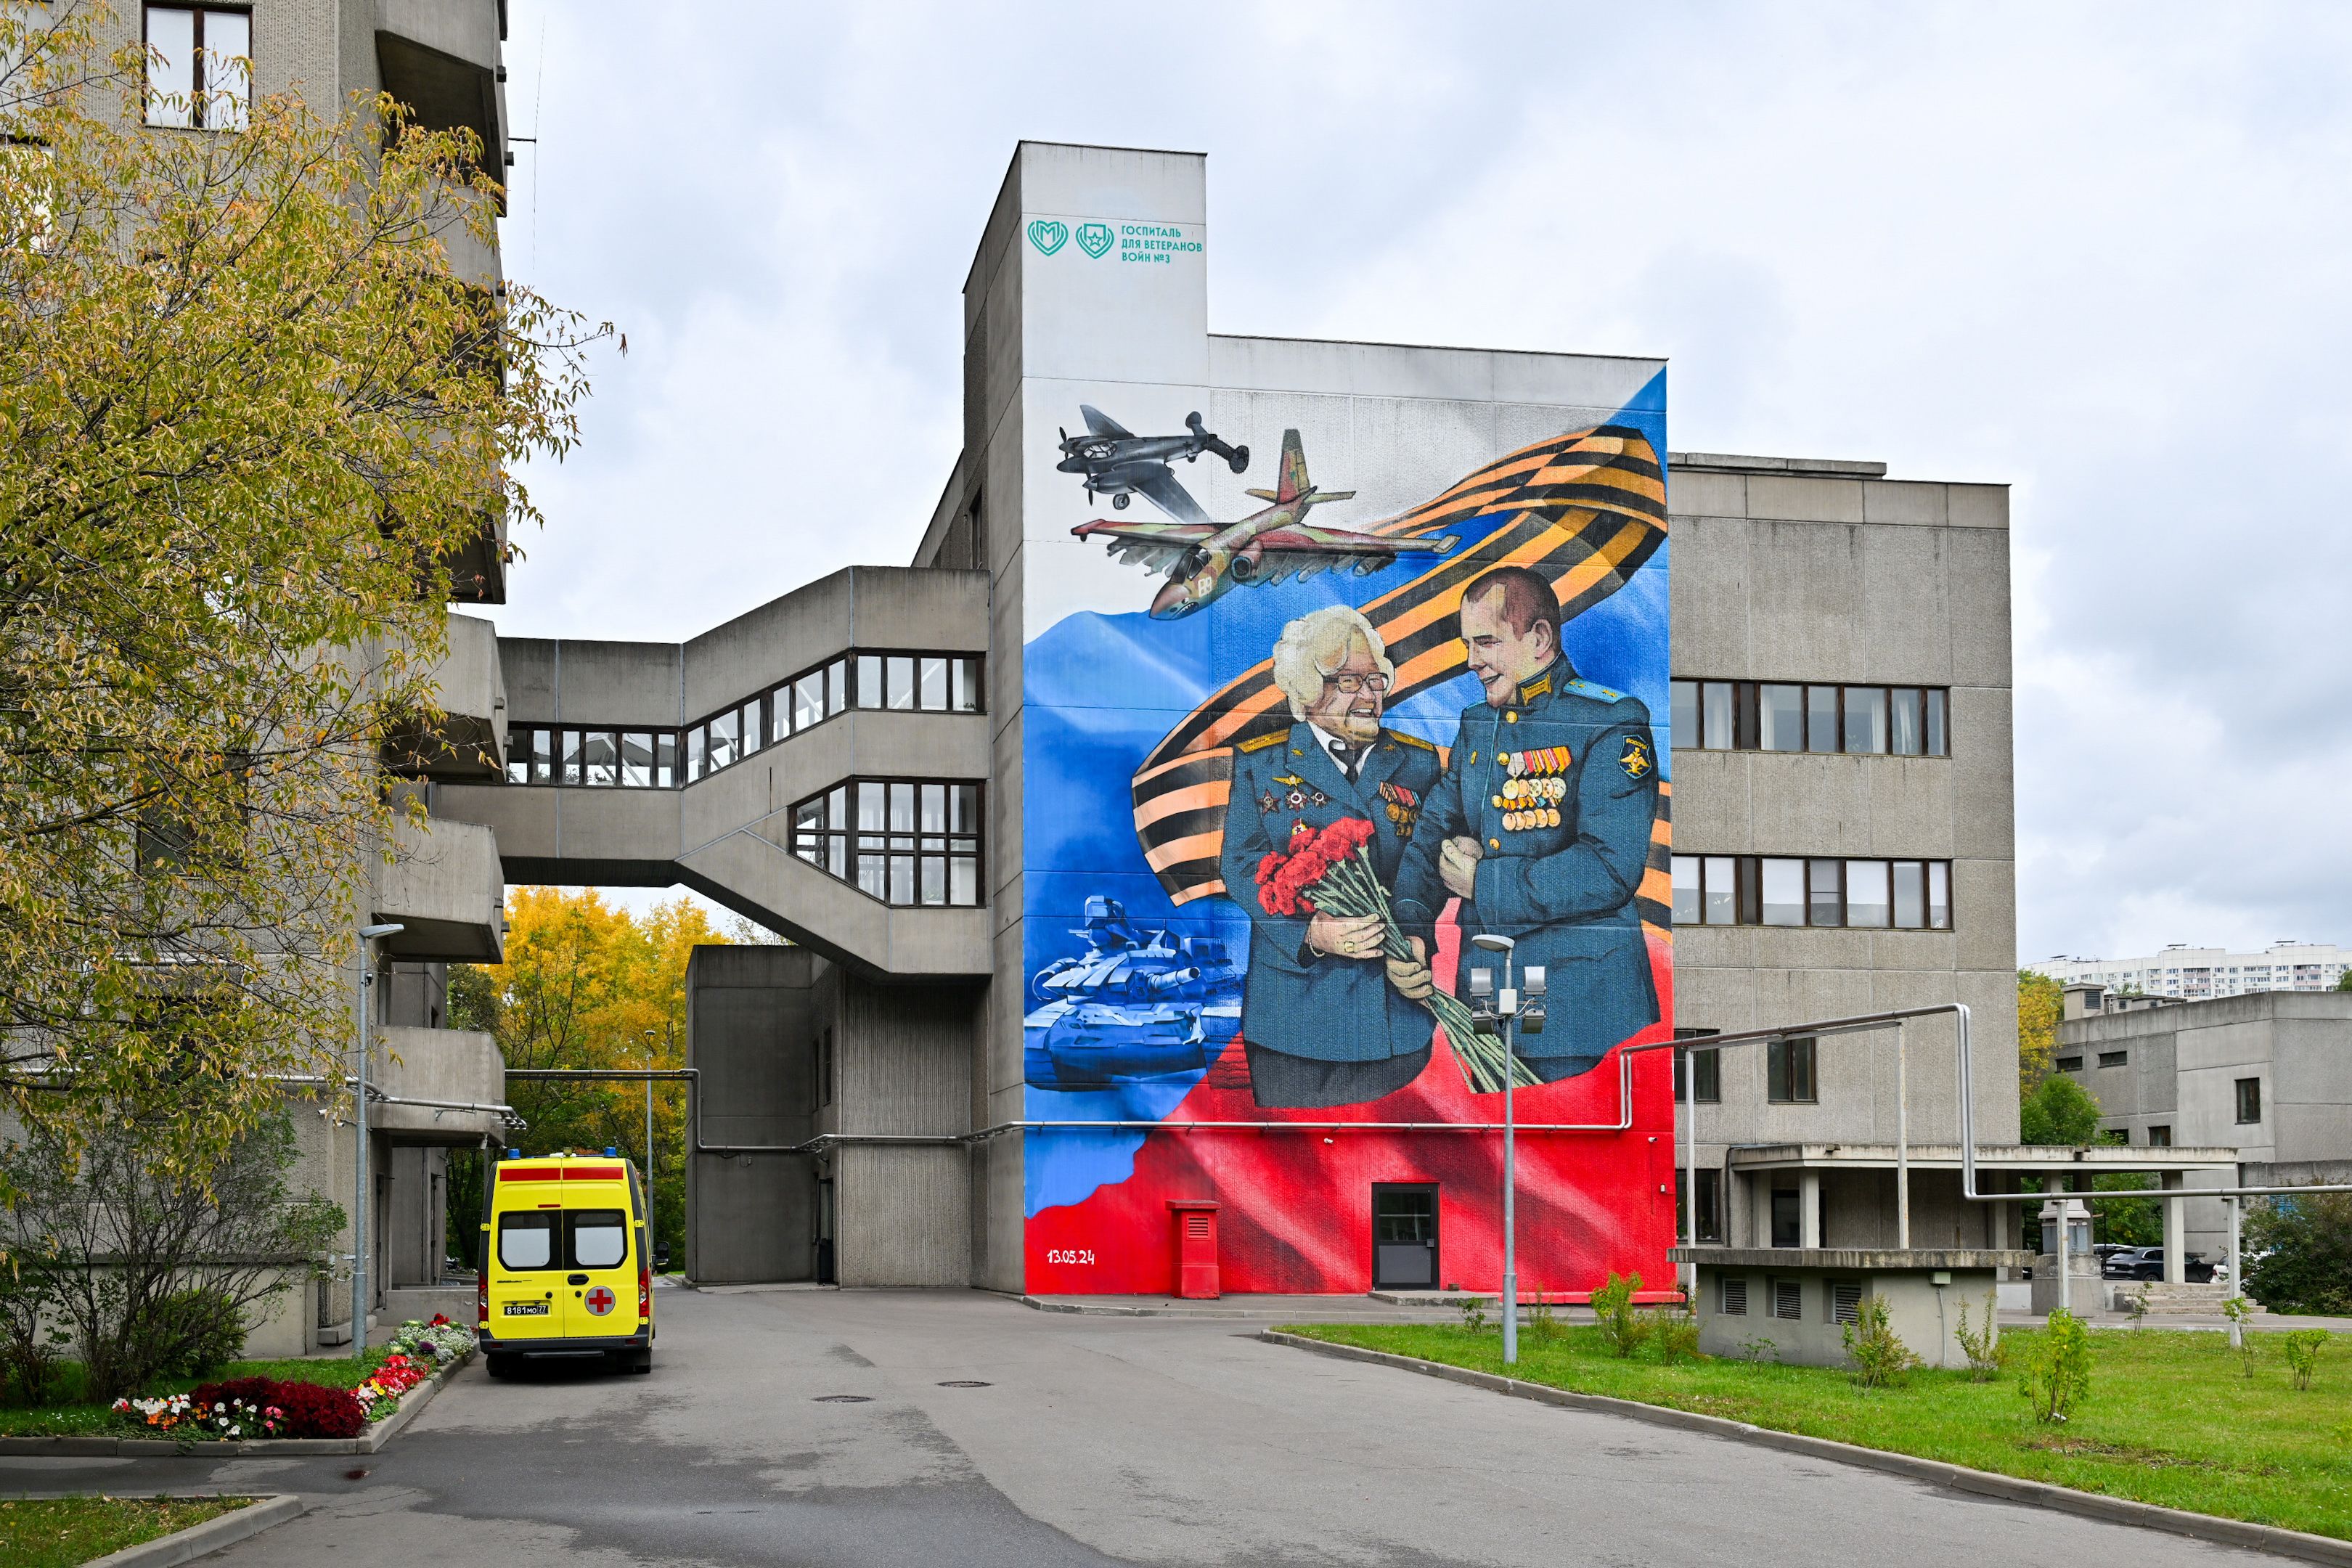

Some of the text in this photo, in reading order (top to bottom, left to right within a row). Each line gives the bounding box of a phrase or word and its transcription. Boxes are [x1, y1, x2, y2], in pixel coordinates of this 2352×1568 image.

[1122, 226, 1181, 237] ГОСПИТАЛЬ
[1122, 239, 1202, 252] ДЛЯ ВЕТЕРАНОВ
[1122, 251, 1151, 262] ВОЙН
[1047, 1249, 1095, 1265] 13.05.24
